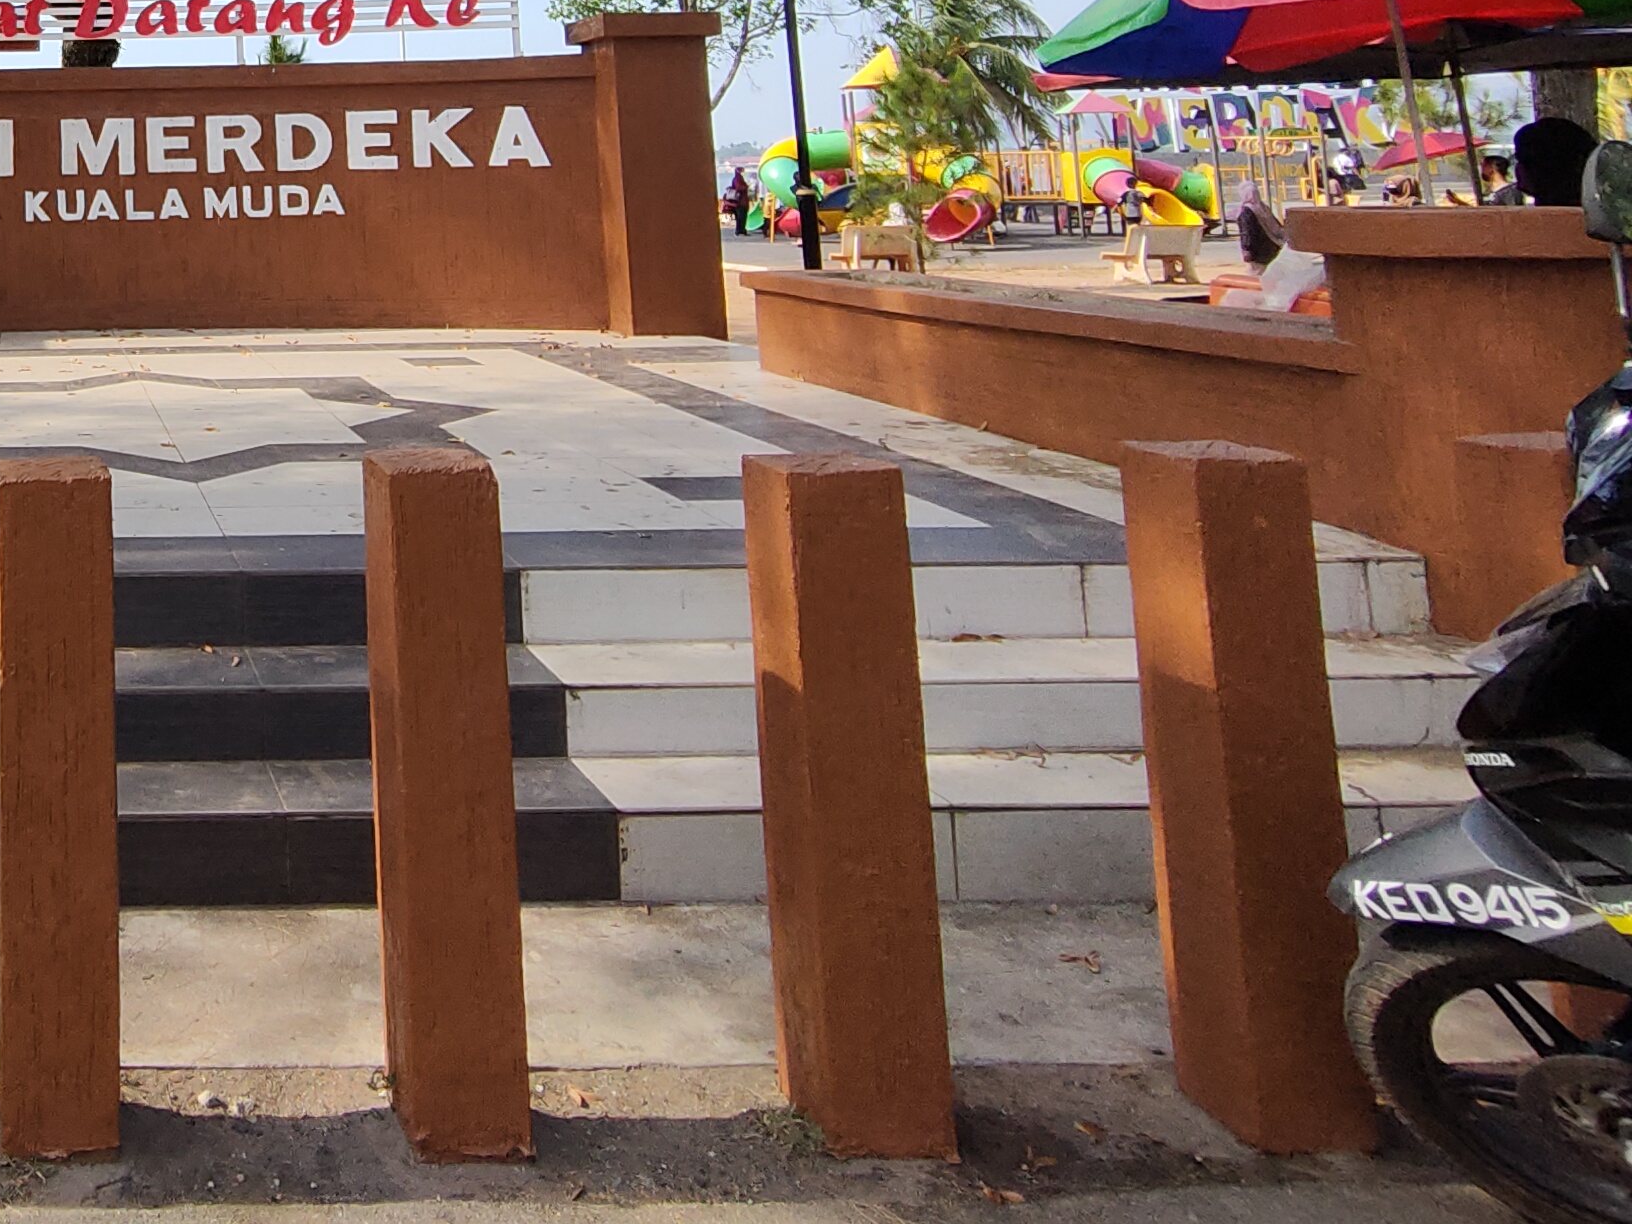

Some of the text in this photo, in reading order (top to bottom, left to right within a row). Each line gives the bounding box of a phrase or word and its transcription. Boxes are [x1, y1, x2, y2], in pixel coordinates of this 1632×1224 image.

[60, 106, 552, 176] MERDEKA
[24, 188, 189, 223] KUALA
[203, 184, 346, 219] MUDA
[1446, 882, 1572, 930] 9415
